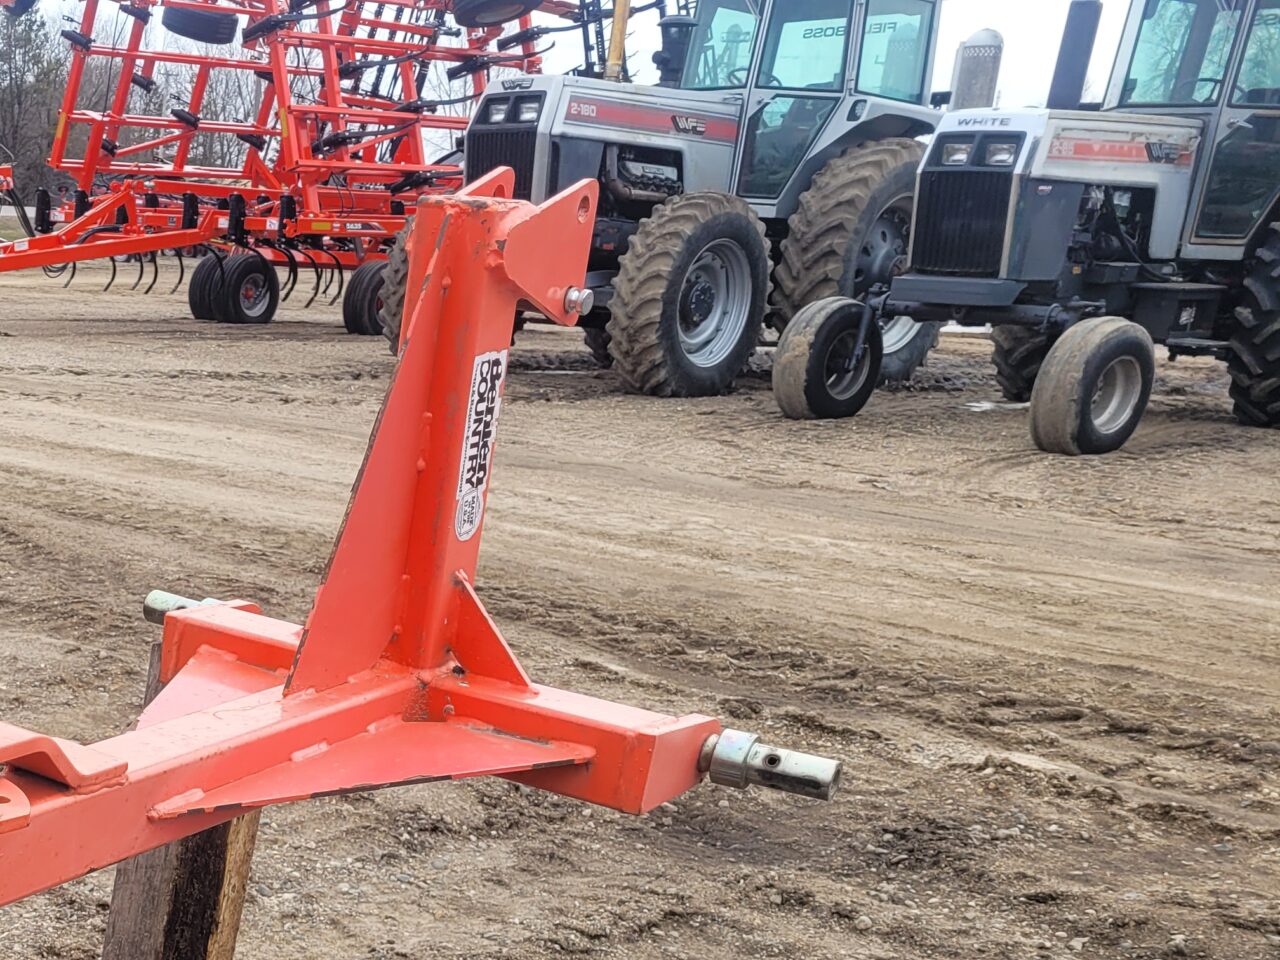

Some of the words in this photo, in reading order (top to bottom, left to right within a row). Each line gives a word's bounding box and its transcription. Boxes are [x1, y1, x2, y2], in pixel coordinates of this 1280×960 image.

[570, 102, 597, 117] 2-180
[957, 117, 1011, 126] WHITE
[465, 359, 491, 488] COUNTRY
